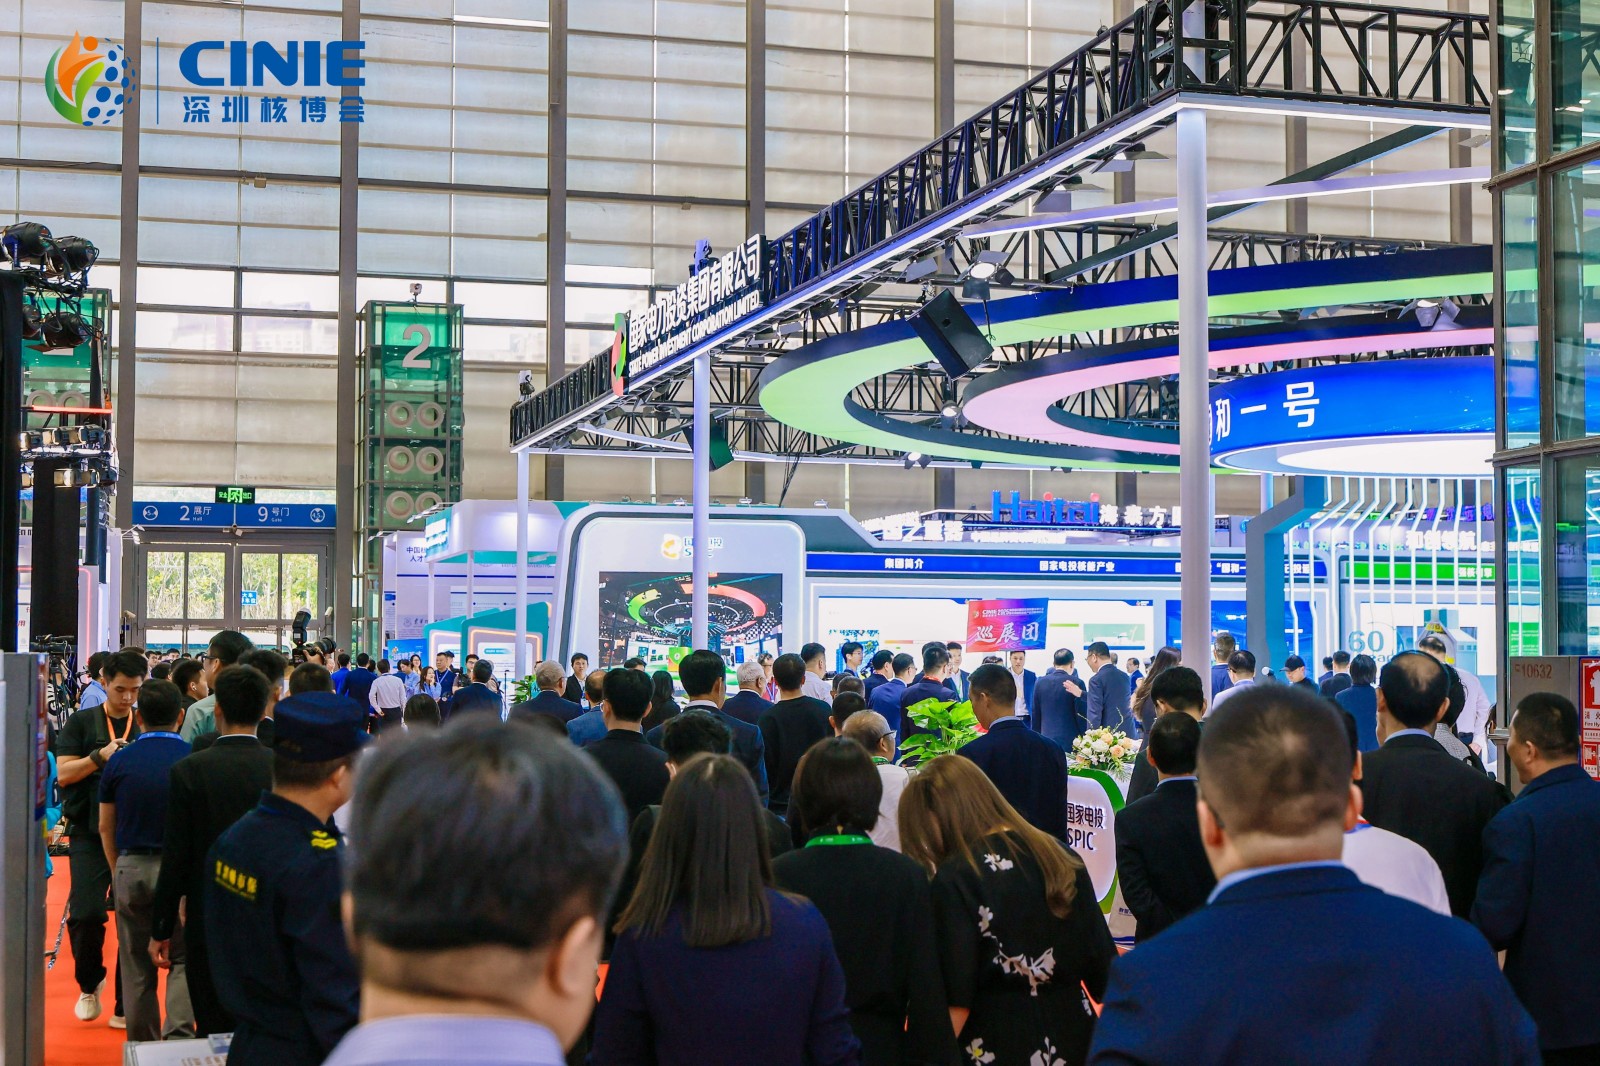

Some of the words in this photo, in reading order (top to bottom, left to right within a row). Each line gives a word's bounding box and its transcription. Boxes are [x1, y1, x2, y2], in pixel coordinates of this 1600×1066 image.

[629, 233, 761, 354] 国家电力投资集团有限公司
[658, 327, 692, 361] INVESTMENT
[692, 303, 734, 342] CORPORATION
[733, 289, 760, 321] LIMITED
[402, 323, 431, 368] 2
[1209, 382, 1320, 446] 和一号
[179, 505, 190, 521] 2
[193, 506, 212, 515] 展厅
[258, 506, 269, 522] 9
[272, 507, 290, 517] 号门
[992, 489, 1100, 524] Haitai
[884, 557, 924, 570] 集团简介
[1039, 560, 1115, 573] 国家电投核能产业
[974, 621, 1040, 644] 巡展团
[1348, 630, 1385, 652] 60
[1067, 803, 1104, 829] 国家电投
[1067, 827, 1094, 851] SPIC
